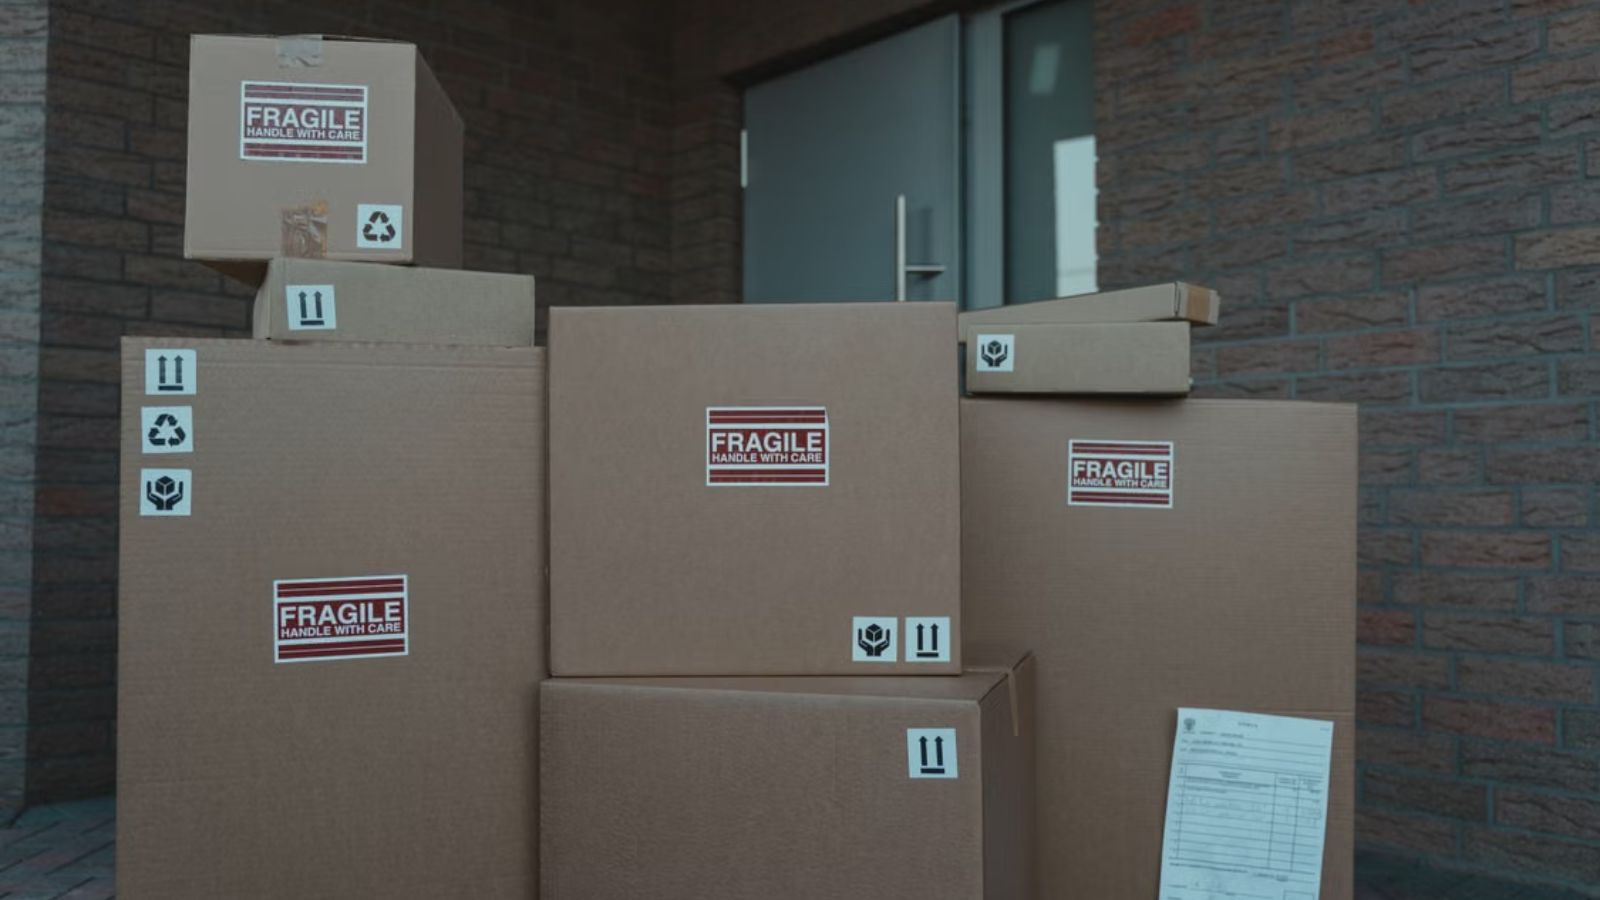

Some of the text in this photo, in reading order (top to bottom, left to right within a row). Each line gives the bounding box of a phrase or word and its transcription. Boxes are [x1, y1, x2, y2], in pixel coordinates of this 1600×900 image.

[247, 107, 360, 129] FRAGILE
[247, 127, 360, 140] HANDLE WITH CARE
[712, 432, 822, 452] FRAGILE
[712, 453, 822, 462] HANDLE WITH CARE
[1073, 461, 1168, 479] FRAGILE
[1073, 478, 1167, 488] HANDLE WITH CARE
[280, 601, 401, 627] FRAGILE
[281, 622, 401, 638] HANDLE WITH CARE
